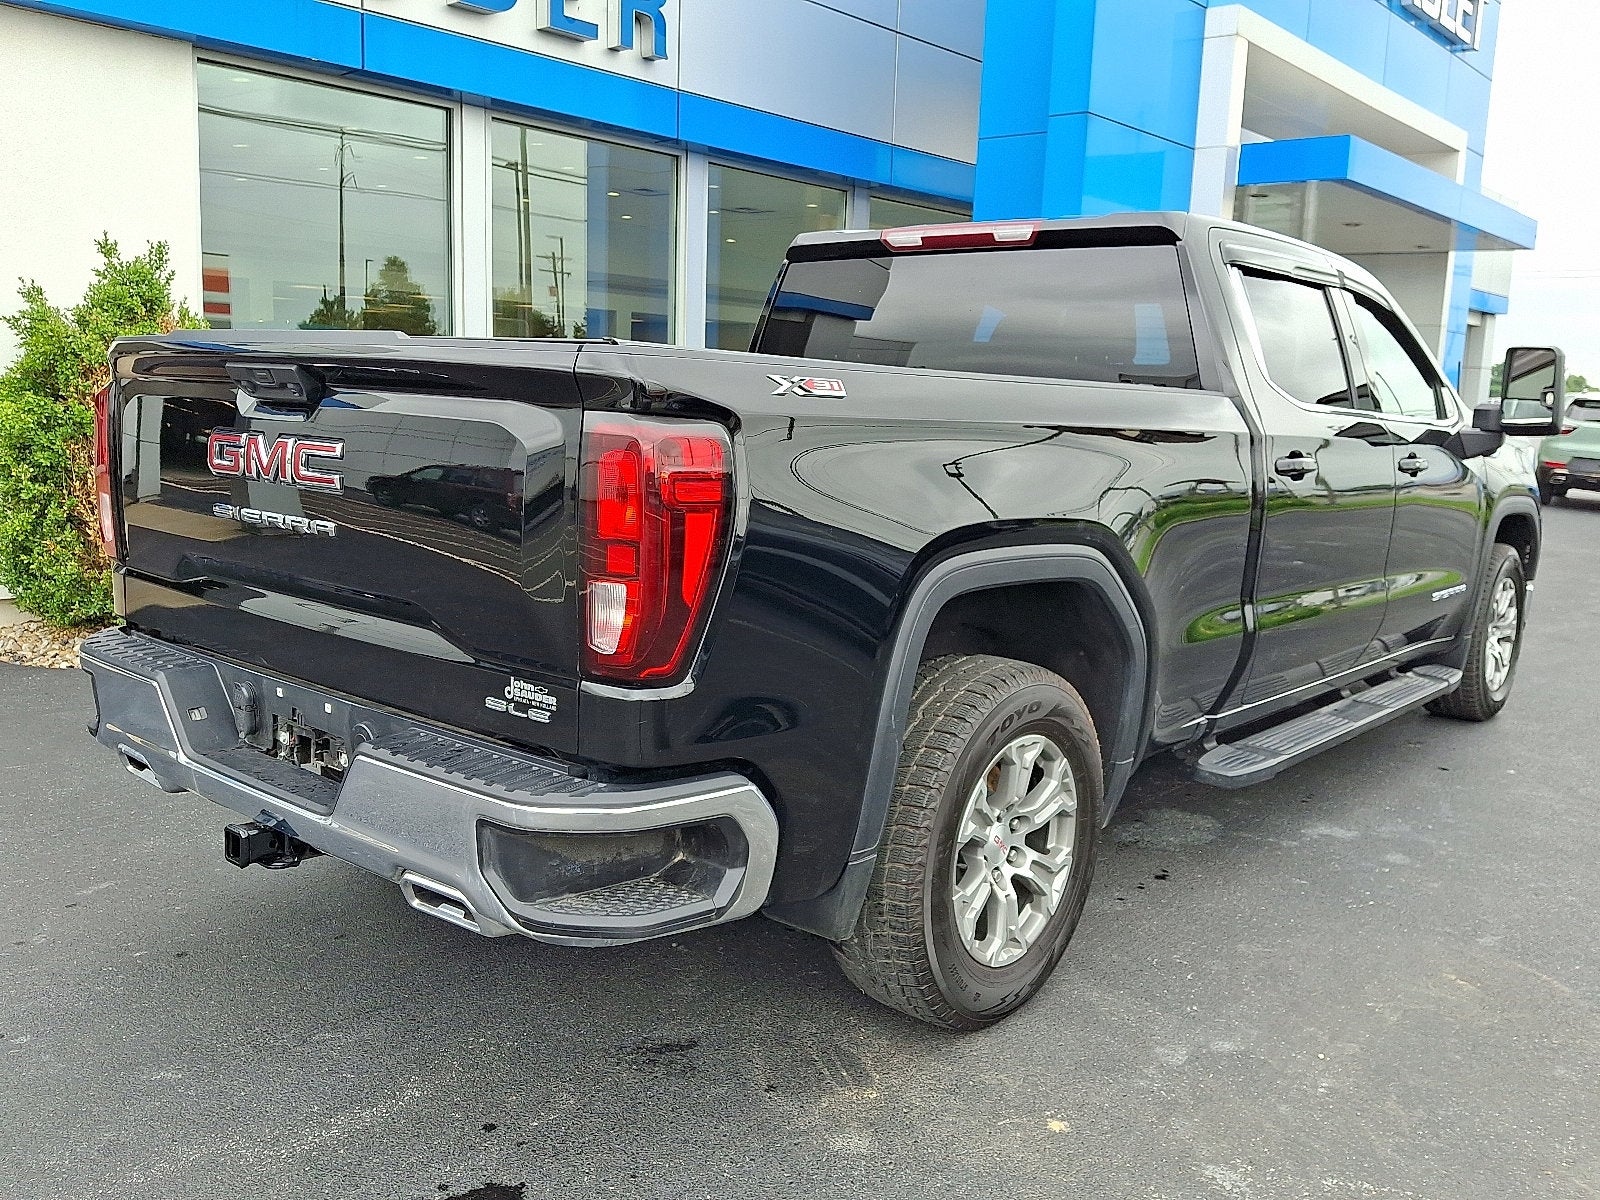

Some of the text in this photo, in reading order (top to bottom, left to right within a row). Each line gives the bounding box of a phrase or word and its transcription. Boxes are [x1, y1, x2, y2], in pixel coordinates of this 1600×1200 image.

[766, 374, 848, 400] X31
[207, 427, 346, 495] GMC
[212, 502, 338, 538] SIERRA
[504, 676, 535, 699] John
[513, 688, 557, 705] SAUDER
[986, 699, 1042, 746] TOYO
